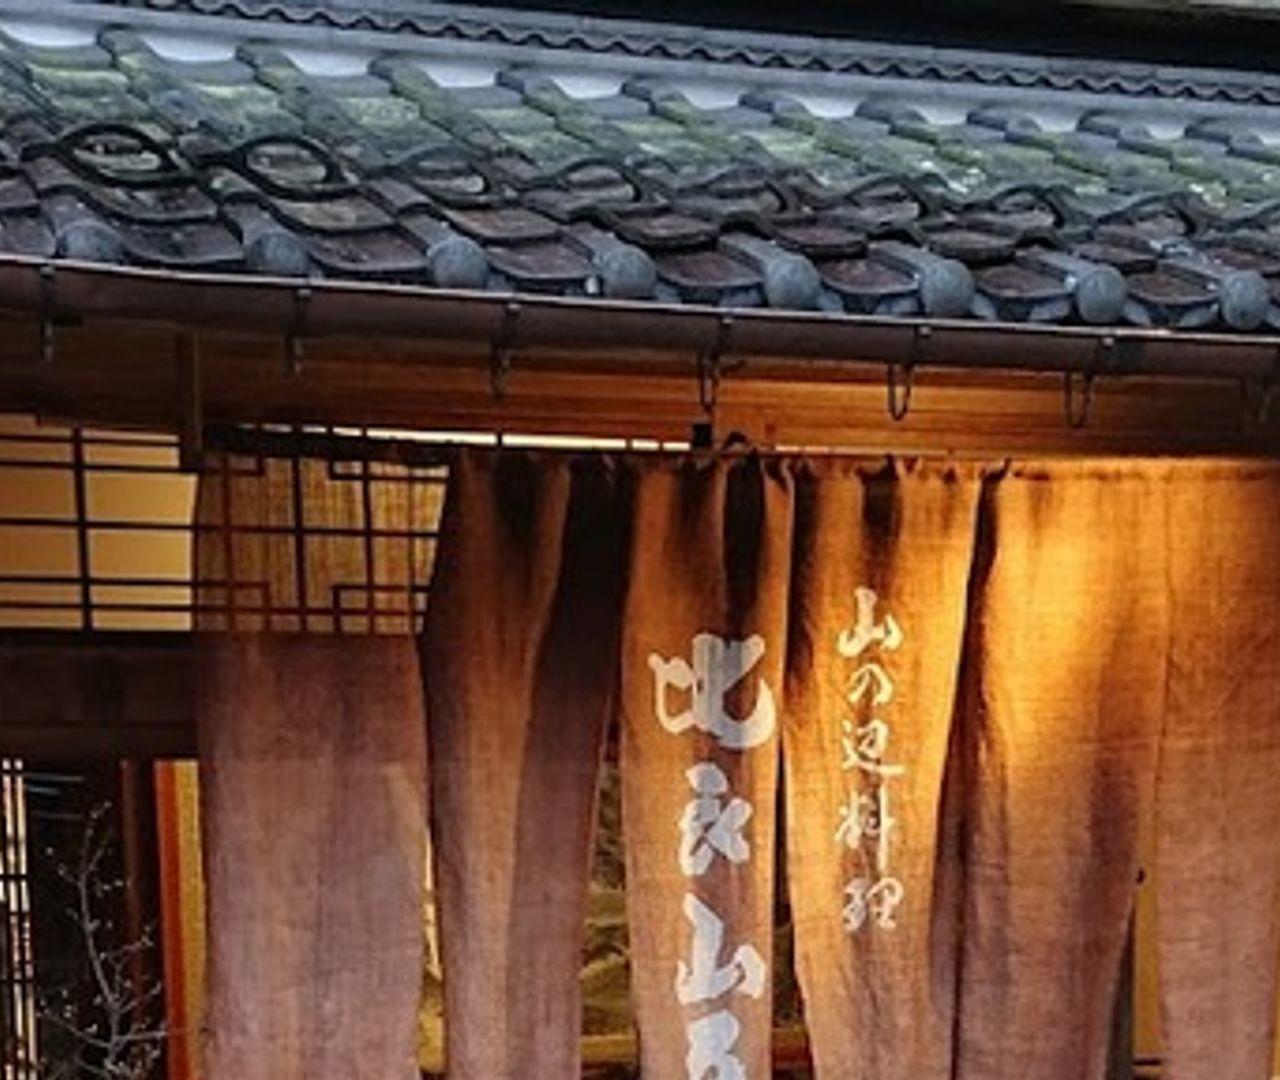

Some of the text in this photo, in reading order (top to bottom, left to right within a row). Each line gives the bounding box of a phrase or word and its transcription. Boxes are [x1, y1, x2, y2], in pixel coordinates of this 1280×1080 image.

[835, 586, 906, 933] 山の辺料理
